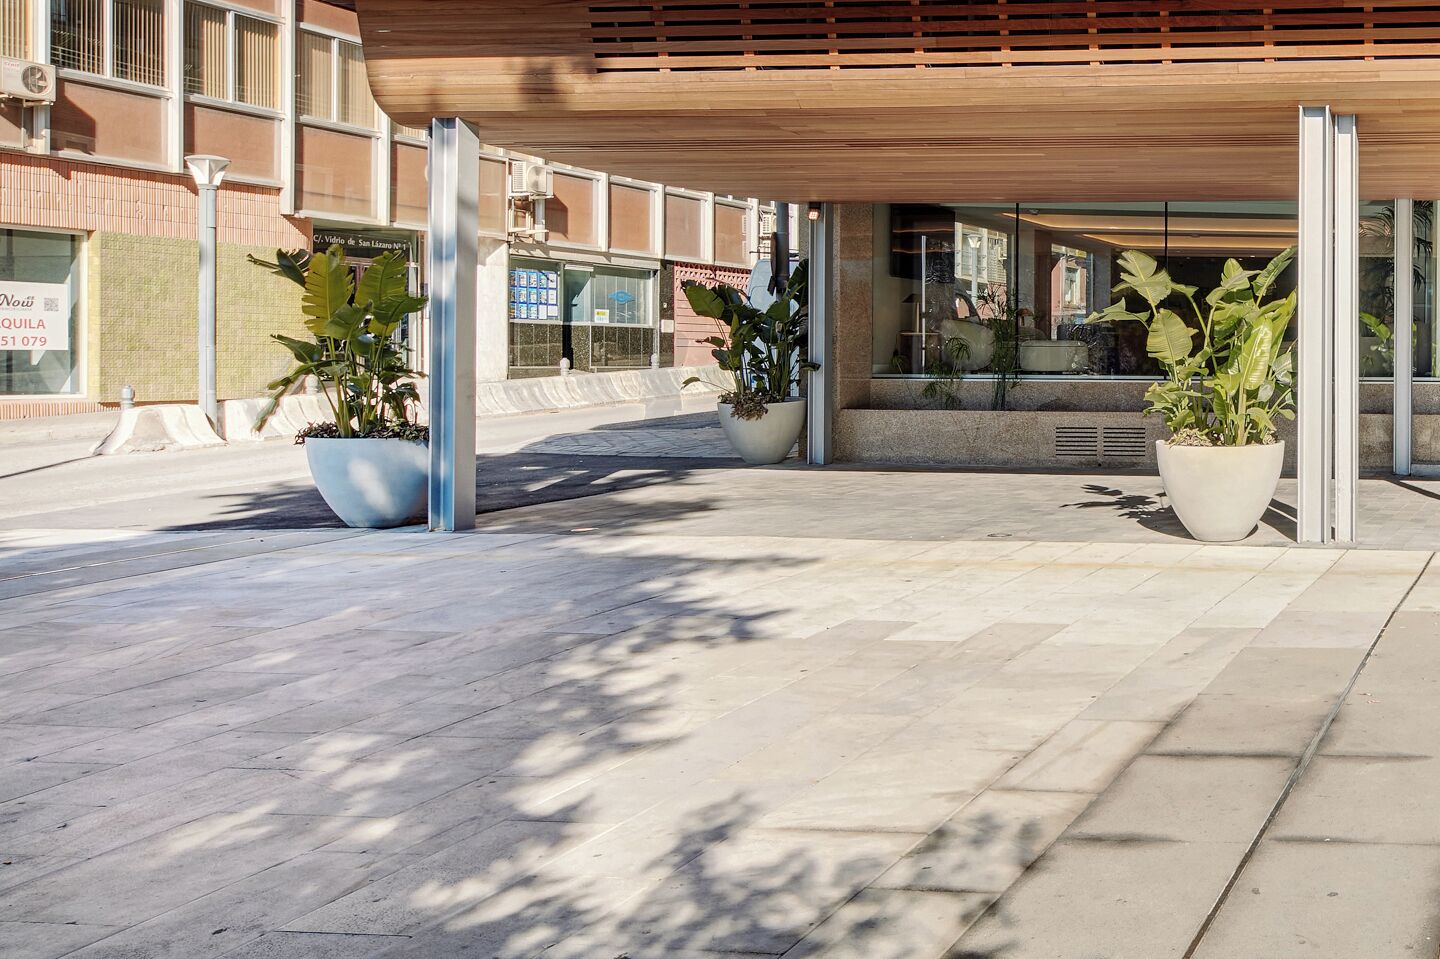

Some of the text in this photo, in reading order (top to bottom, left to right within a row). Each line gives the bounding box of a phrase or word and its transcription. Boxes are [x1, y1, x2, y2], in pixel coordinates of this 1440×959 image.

[347, 238, 356, 246] de
[358, 239, 370, 248] San
[371, 240, 392, 250] Lázaro
[402, 243, 407, 251] 1
[0, 318, 46, 330] QUILA
[22, 336, 47, 346] 079
